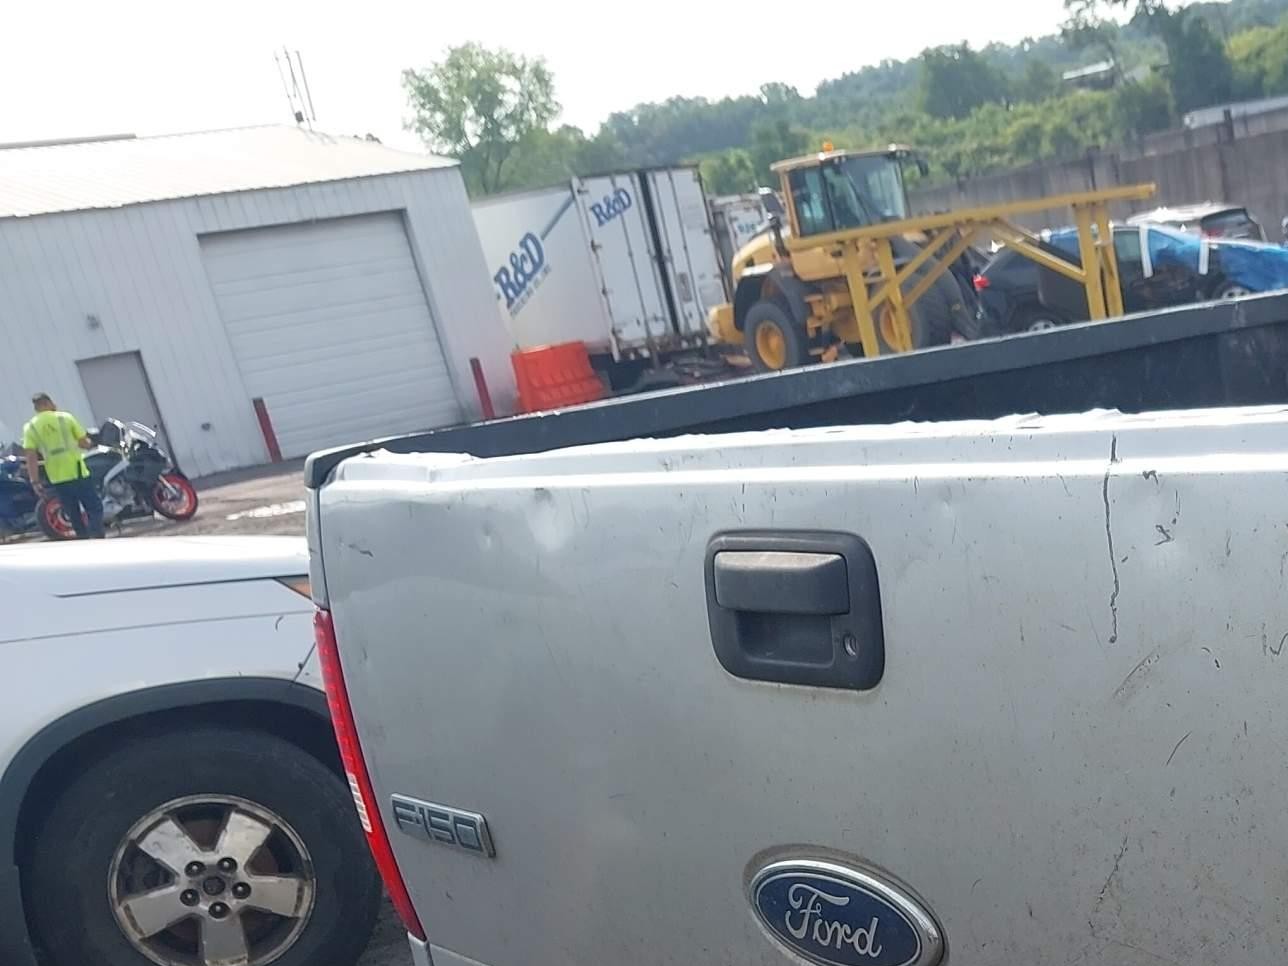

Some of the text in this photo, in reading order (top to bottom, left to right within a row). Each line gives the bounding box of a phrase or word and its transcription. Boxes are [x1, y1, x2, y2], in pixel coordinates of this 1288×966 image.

[591, 188, 632, 227] R&D
[494, 232, 544, 309] R&D
[785, 883, 882, 957] Ford
